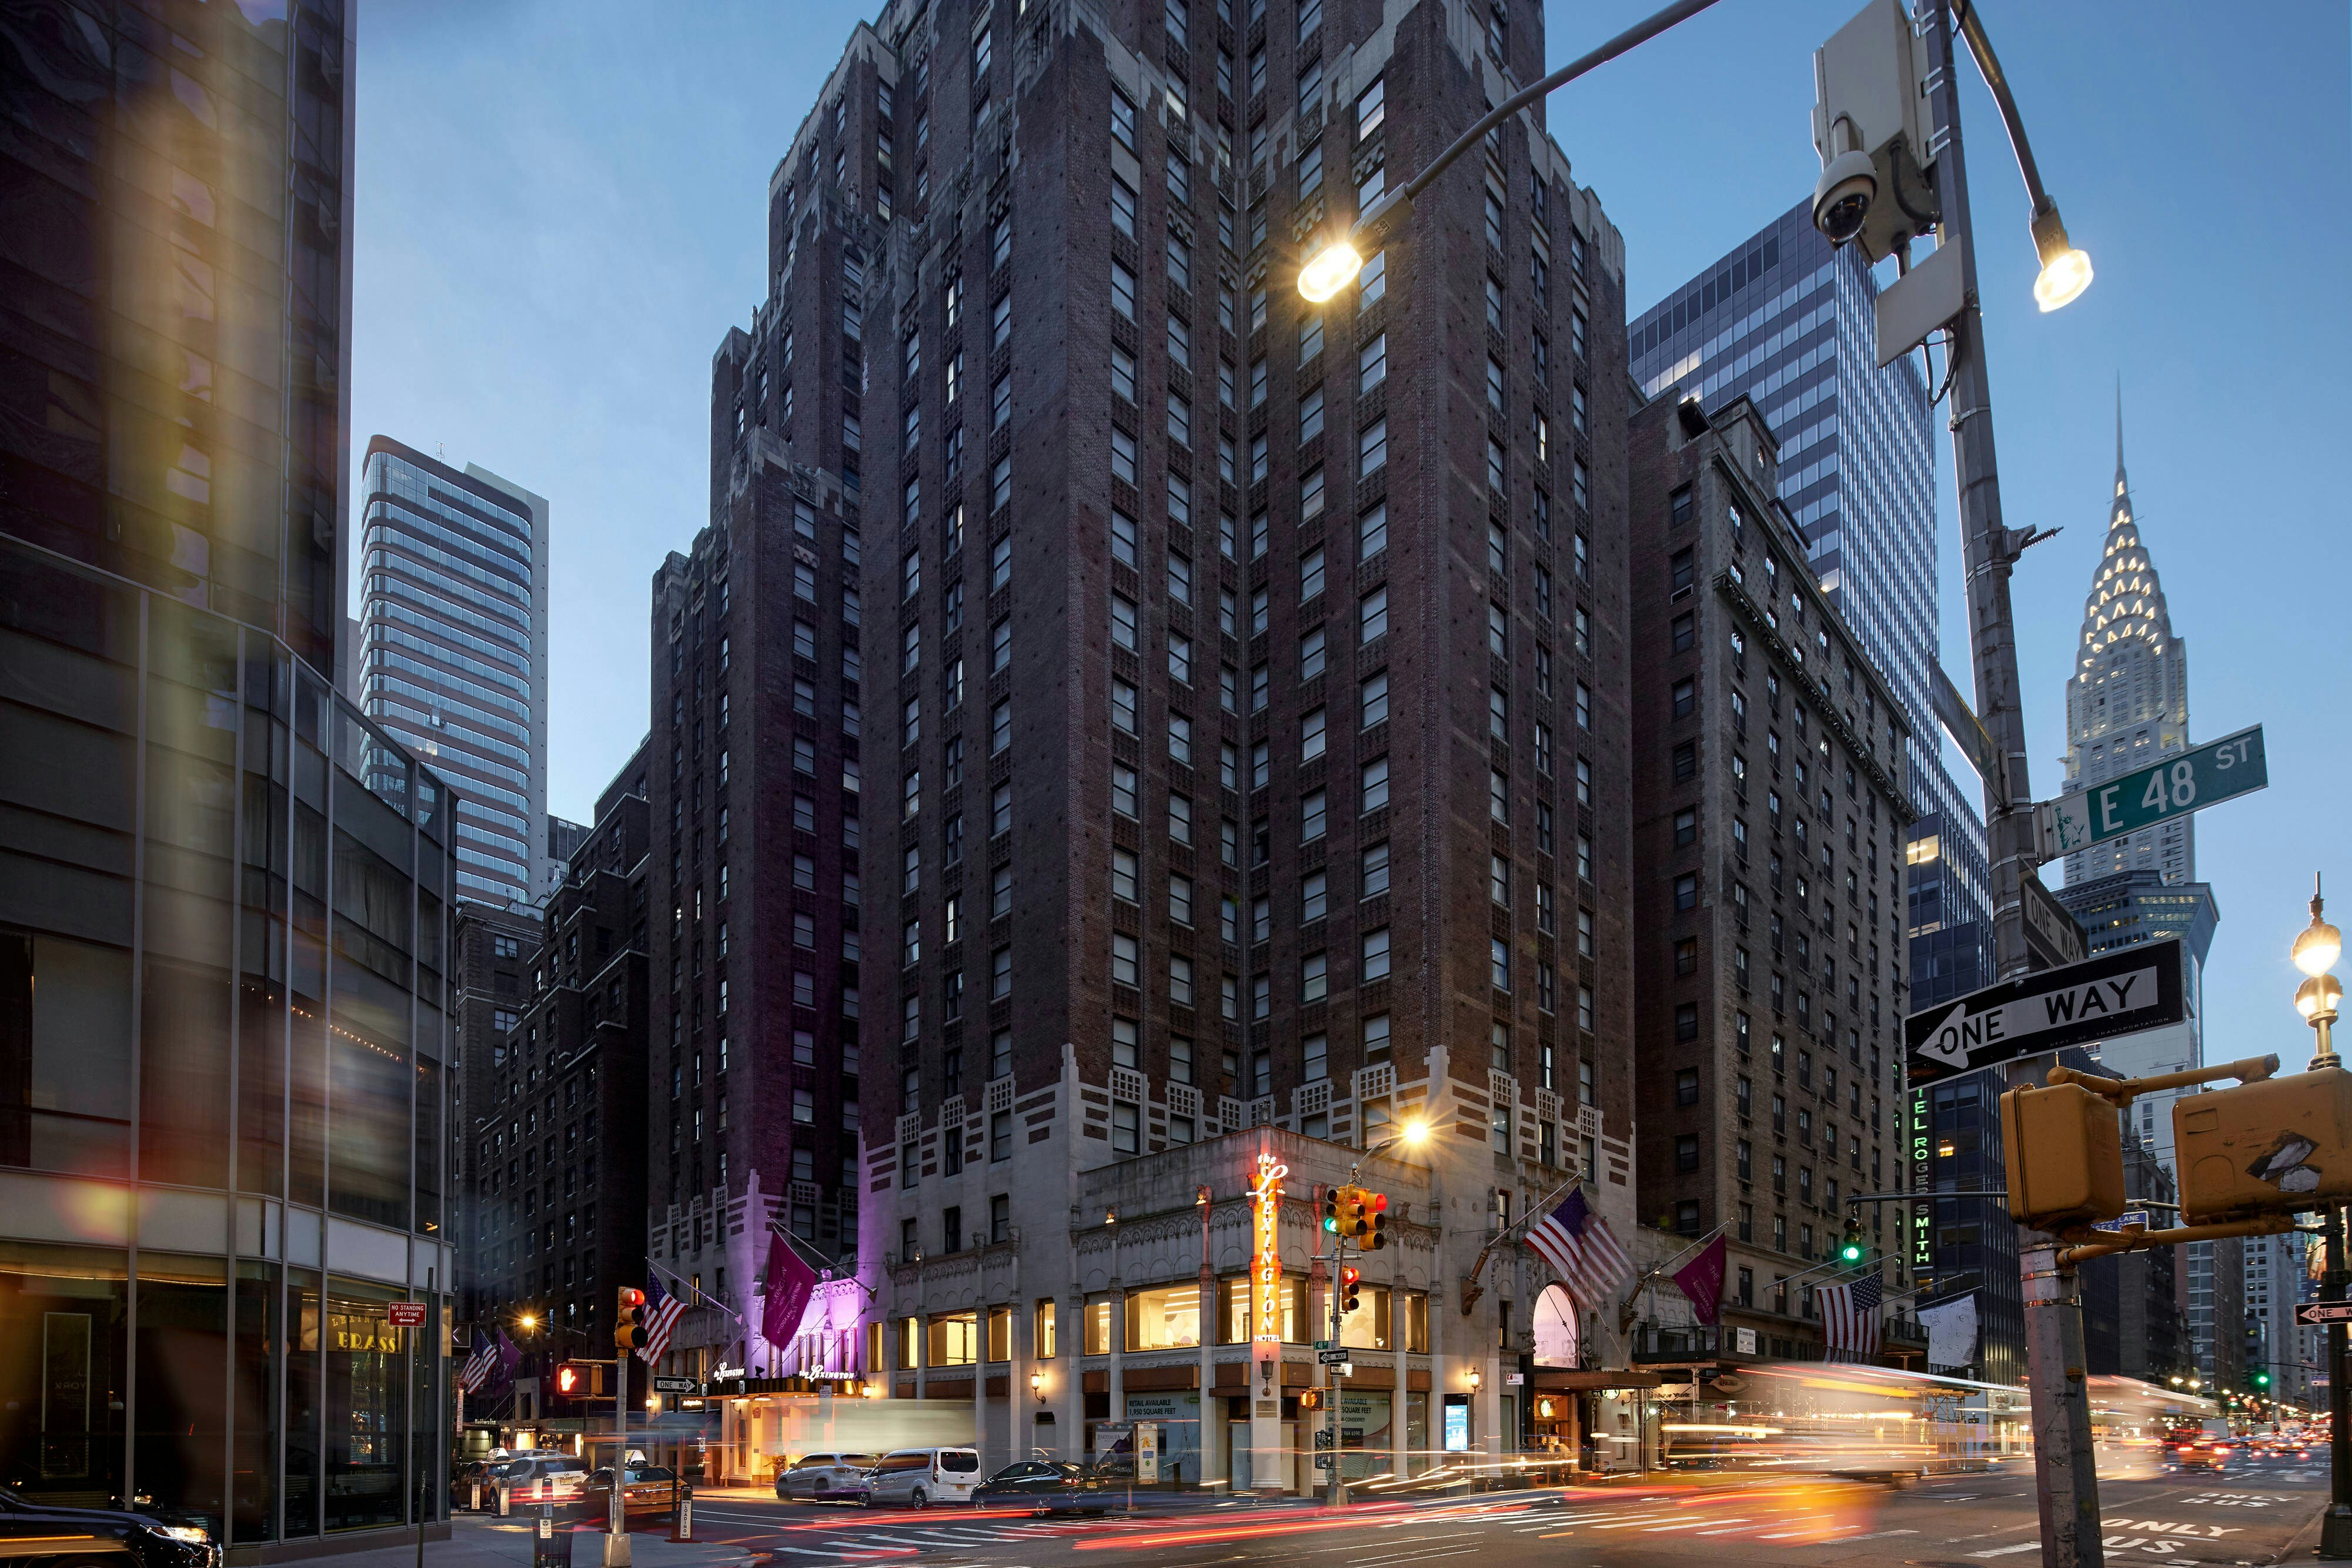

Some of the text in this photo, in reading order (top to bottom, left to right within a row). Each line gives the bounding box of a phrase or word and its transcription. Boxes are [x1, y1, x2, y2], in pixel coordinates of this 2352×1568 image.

[2100, 737, 2251, 833] E 48 ST
[2032, 894, 2080, 962] ONE WAY
[1939, 975, 2137, 1055] ONE WAY
[2096, 1017, 2170, 1037] TRANSPORTATION
[1257, 1152, 1277, 1164] the
[1915, 1204, 1929, 1263] SMITH
[1245, 1165, 1289, 1331] LEXINGTON
[2308, 1309, 2333, 1319] ONE
[338, 1331, 396, 1353] BRASS
[804, 1365, 854, 1382] LEXINGTON
[2179, 1498, 2276, 1507] BUS
[2197, 1493, 2302, 1502] ONLY
[2100, 1518, 2245, 1537] ONLY
[2102, 1535, 2187, 1554] US
